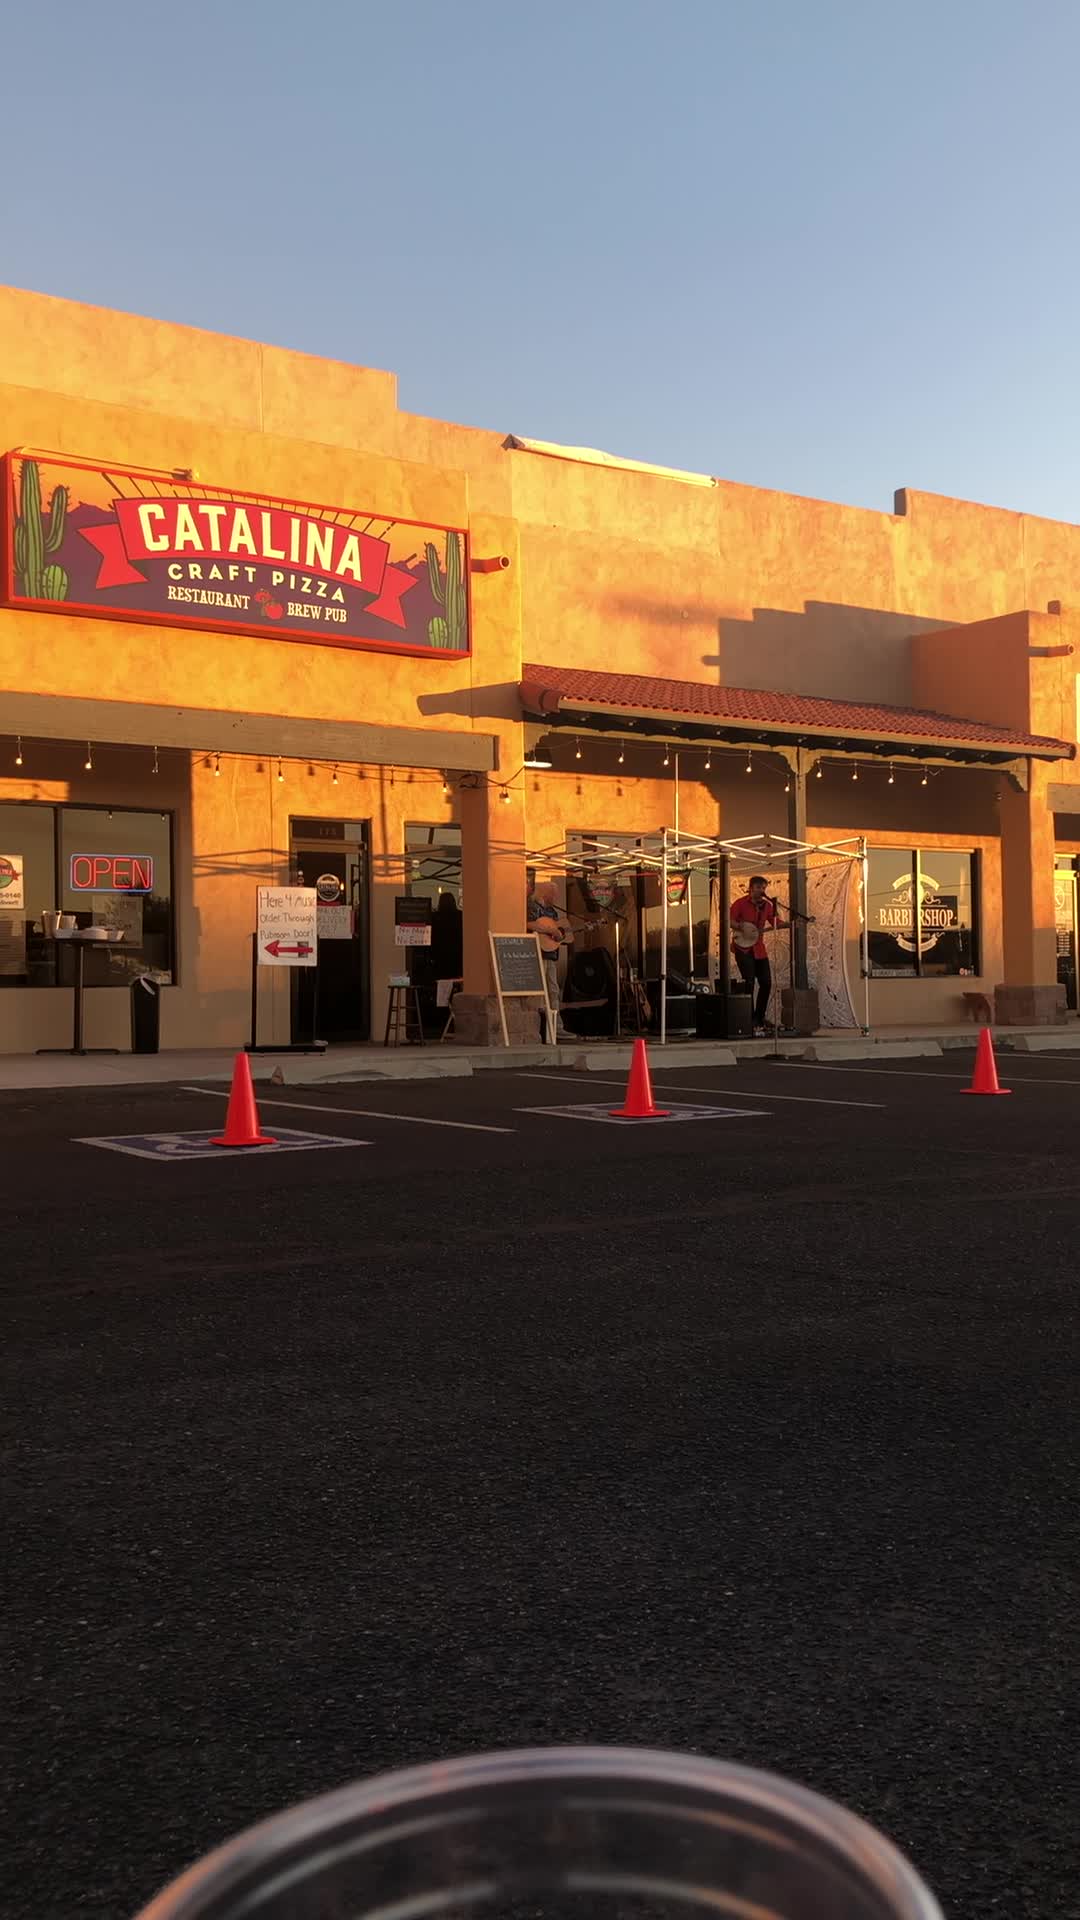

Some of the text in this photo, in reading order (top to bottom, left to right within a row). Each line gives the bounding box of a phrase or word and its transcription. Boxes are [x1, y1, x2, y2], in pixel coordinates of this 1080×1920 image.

[138, 503, 362, 582] CATALINA
[168, 563, 345, 603] CRAFT PIZZA
[168, 586, 347, 623] RESTAURANT BREW PUB
[73, 856, 150, 888] OPEN
[260, 891, 283, 908] Here
